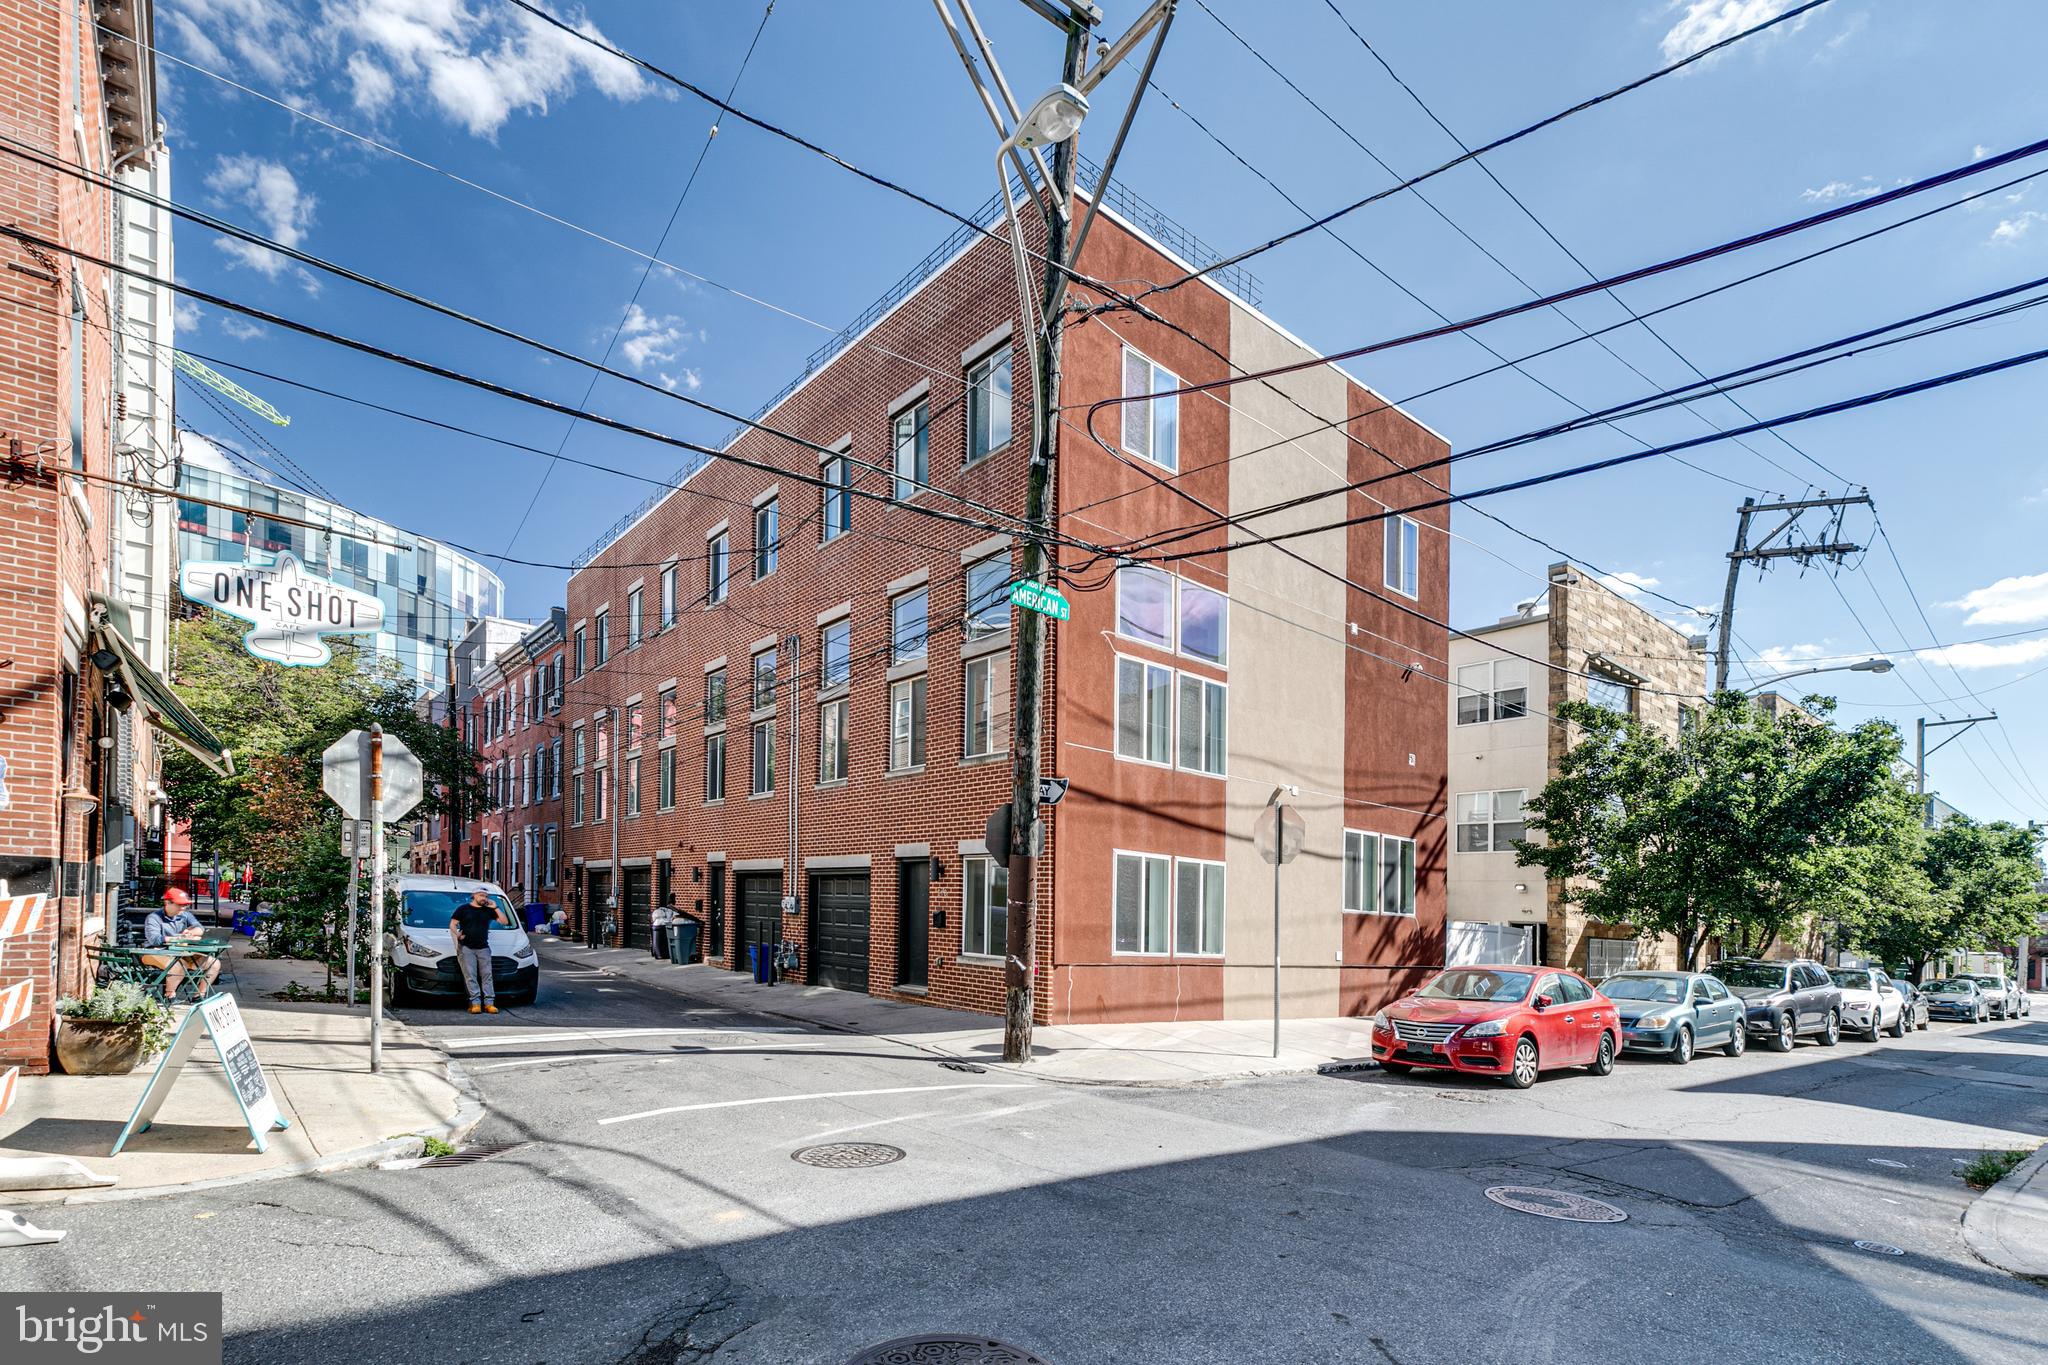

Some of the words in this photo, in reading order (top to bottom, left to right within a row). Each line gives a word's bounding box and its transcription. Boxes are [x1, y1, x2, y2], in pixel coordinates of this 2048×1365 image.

[214, 572, 272, 612] ONE
[287, 587, 358, 628] SHOT
[1012, 588, 1058, 615] AMERICAN
[1061, 607, 1067, 618] ST
[1040, 786, 1051, 796] AY
